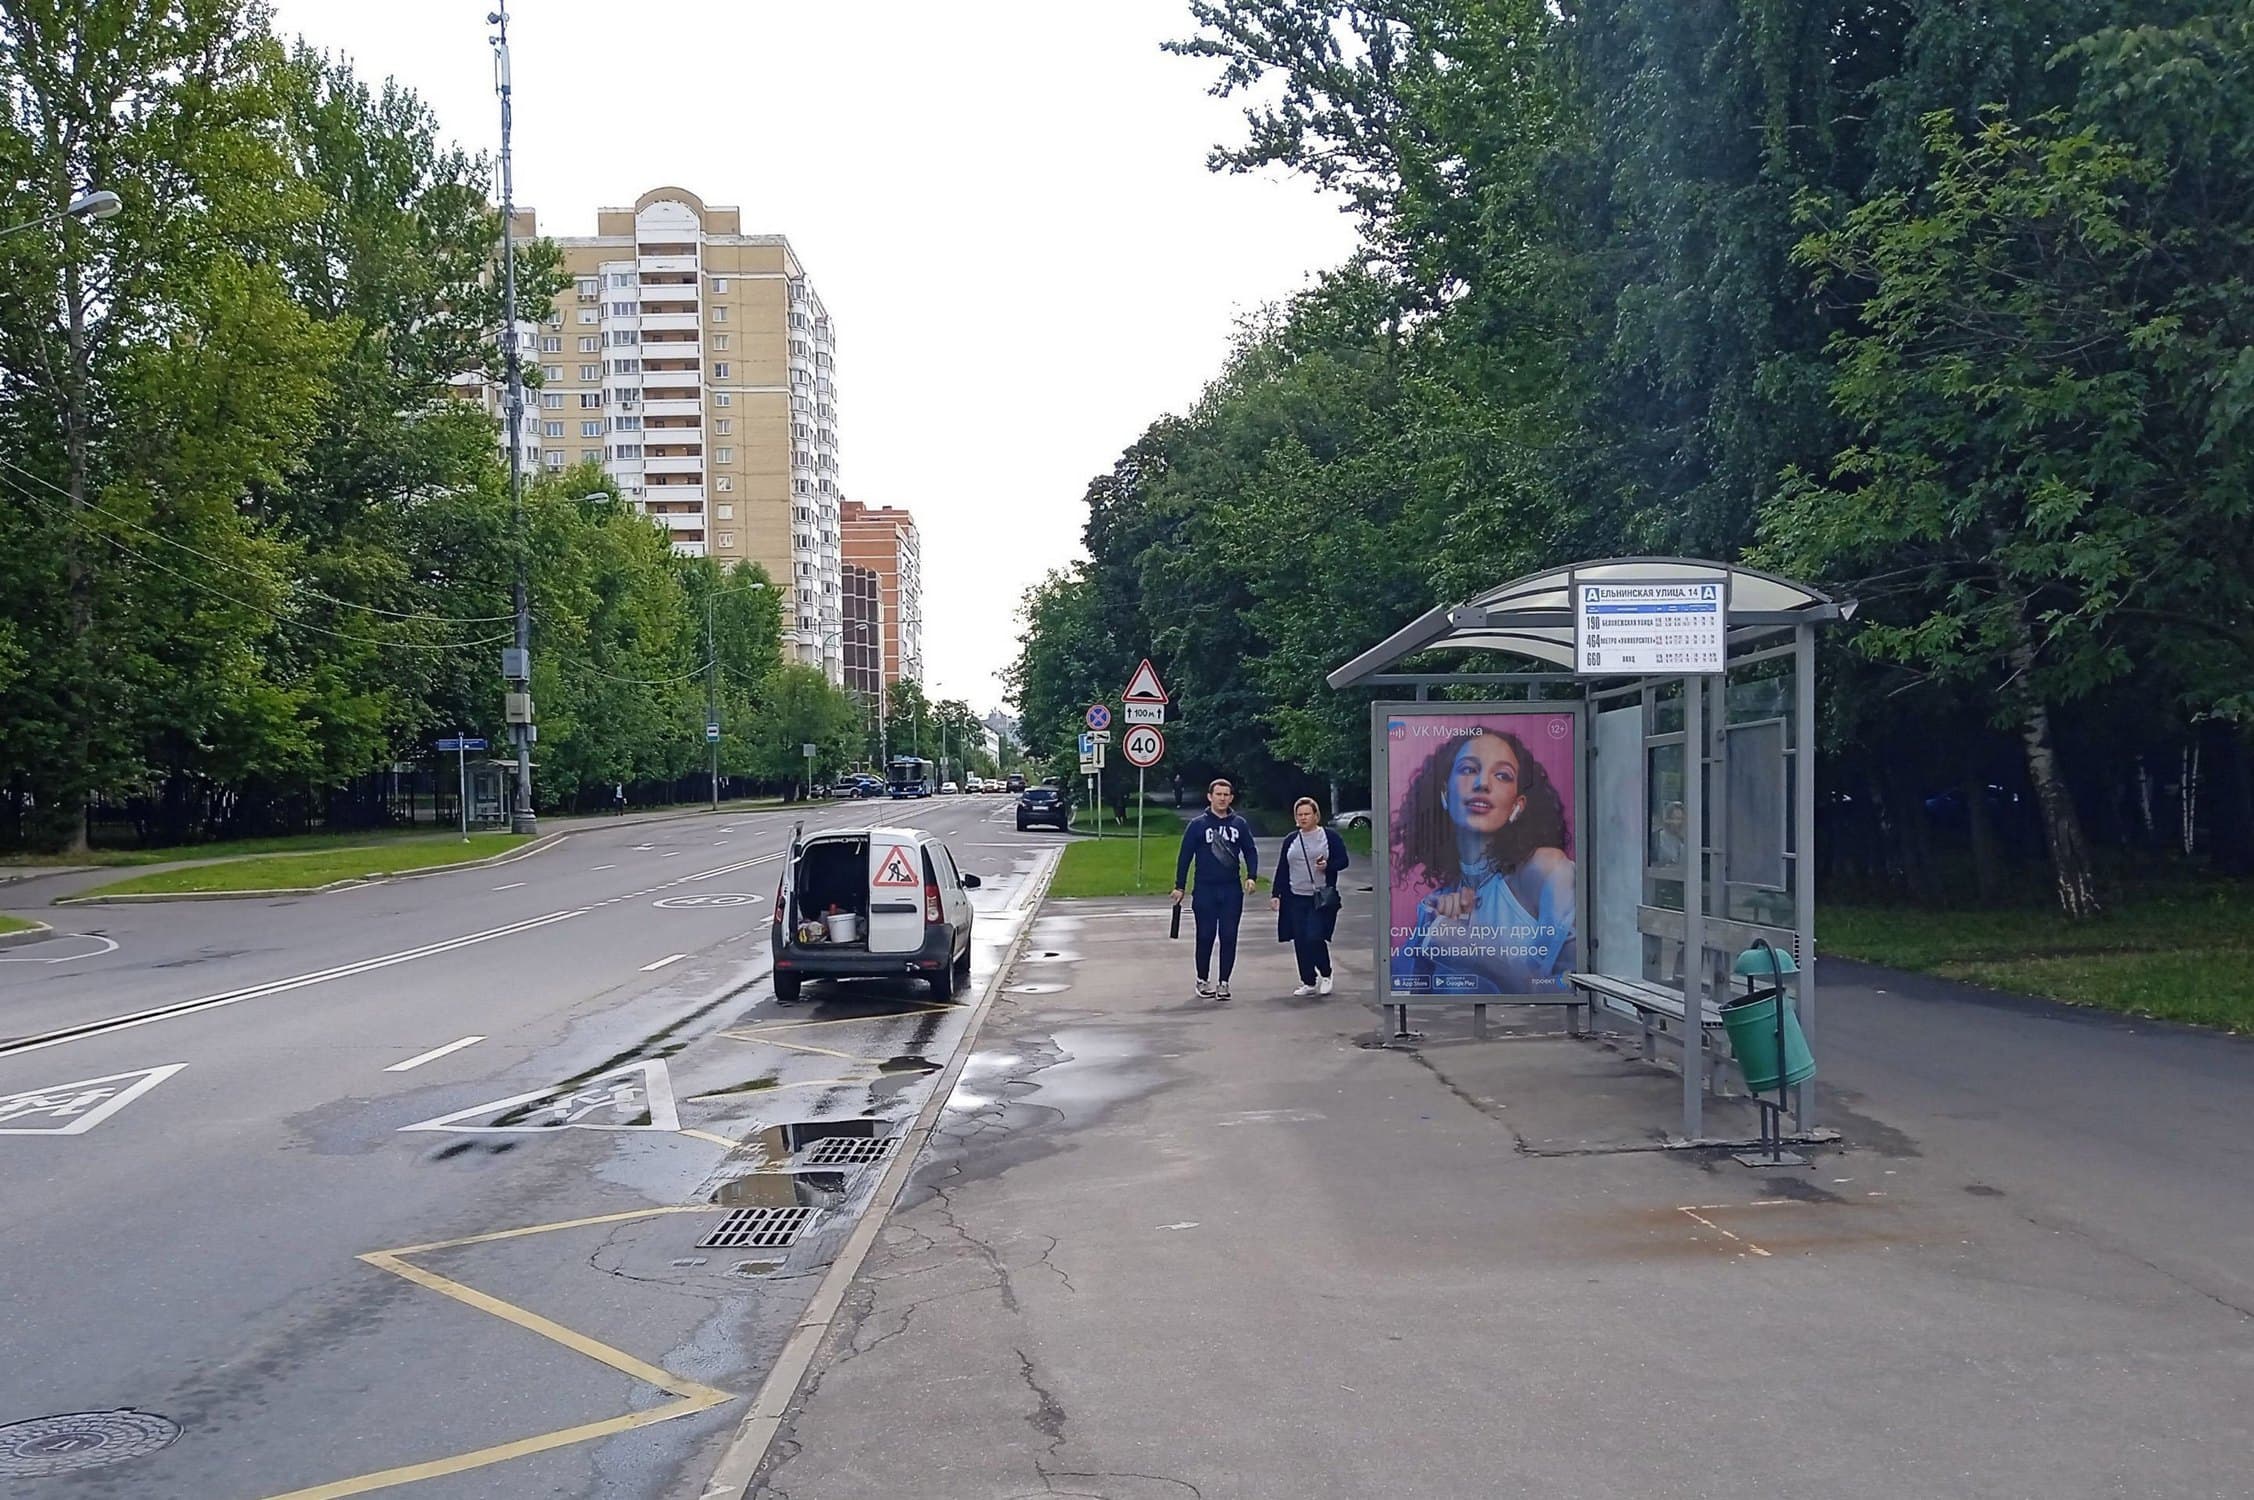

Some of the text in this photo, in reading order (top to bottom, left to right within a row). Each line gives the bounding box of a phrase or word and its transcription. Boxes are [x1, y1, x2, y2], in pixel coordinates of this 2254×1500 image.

[1600, 588, 1654, 598] ЕЛЬНИНСКАЯ
[1688, 588, 1698, 597] 14
[1586, 616, 1600, 630] 190
[1586, 634, 1600, 648] 464
[1586, 652, 1601, 666] 660
[1134, 709, 1148, 718] 100
[1413, 726, 1483, 740] VK Музыка
[1550, 725, 1565, 734] 12+
[1130, 737, 1156, 754] 40
[1390, 924, 1555, 941] слушайте друг друга
[1390, 944, 1548, 960] и открывайте новое
[1401, 979, 1414, 988] App
[1446, 979, 1476, 988] Google Play
[1531, 977, 1556, 985] проект
